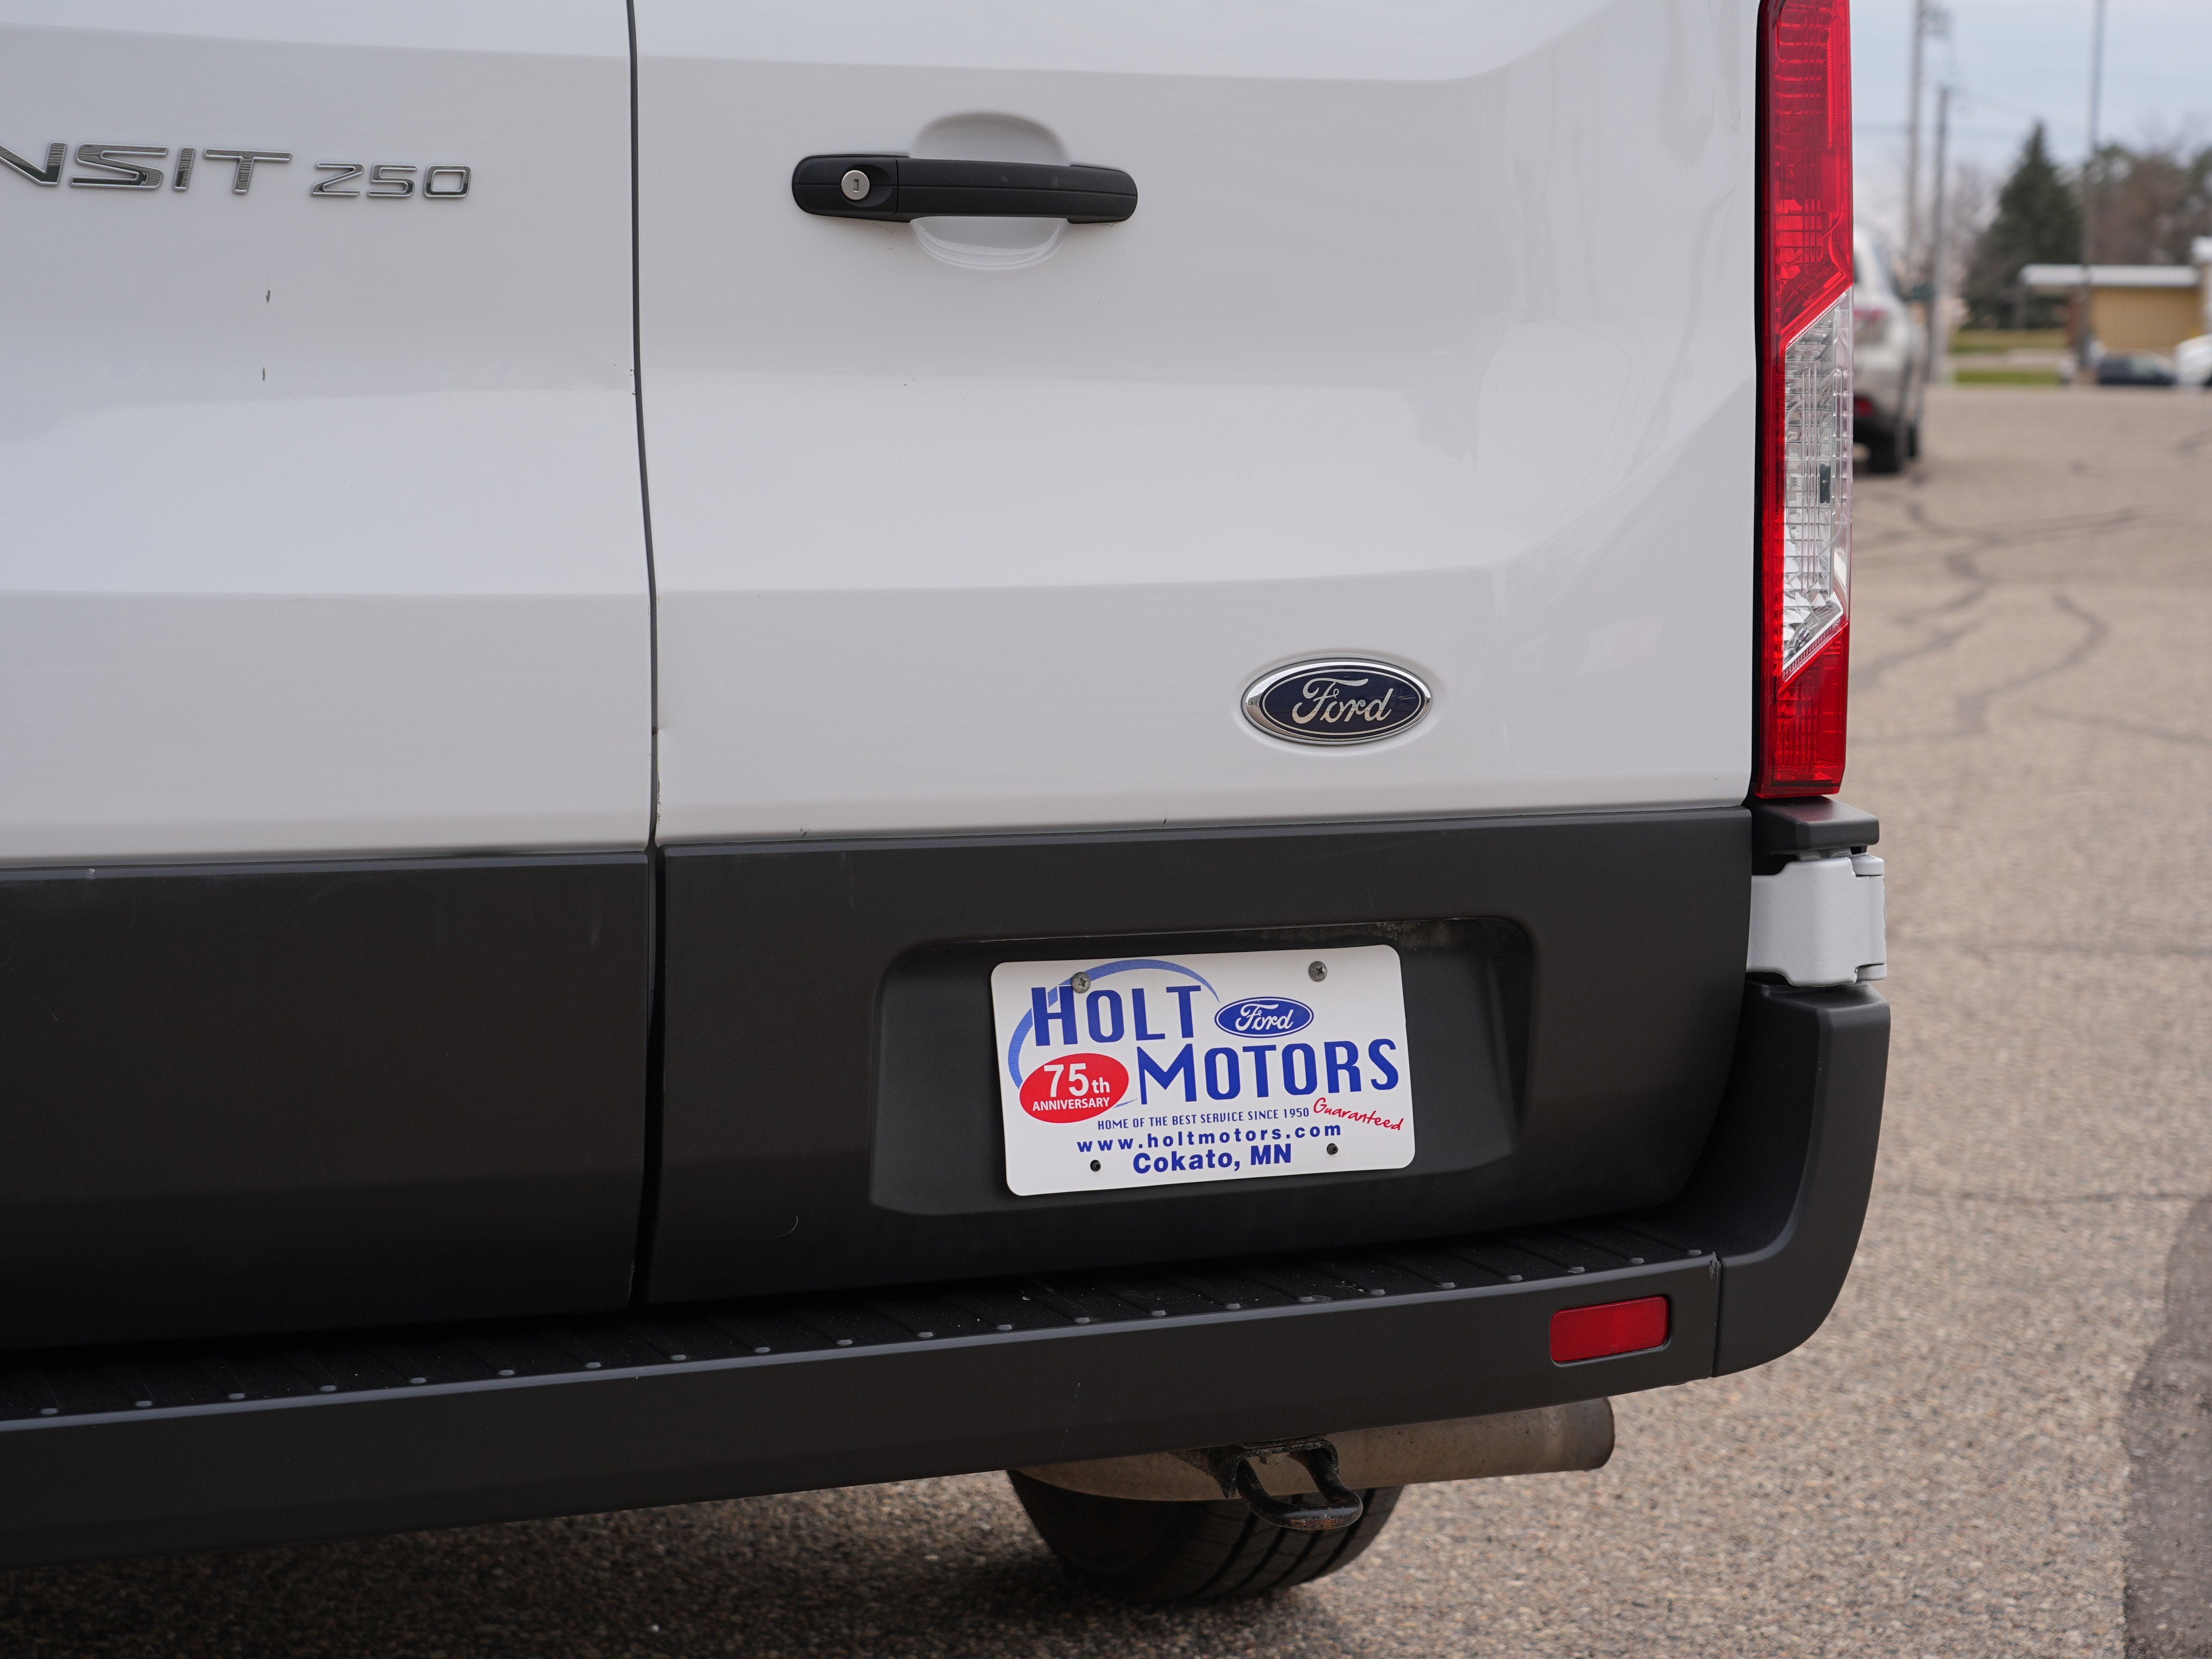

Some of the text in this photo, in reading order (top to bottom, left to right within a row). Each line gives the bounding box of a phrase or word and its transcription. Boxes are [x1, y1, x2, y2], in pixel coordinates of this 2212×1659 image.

[310, 161, 472, 198] 250
[1292, 677, 1394, 724] Ford
[1031, 985, 1202, 1047] HOLT
[1235, 1003, 1294, 1031] Ford
[1043, 1063, 1110, 1097] 75th
[1137, 1038, 1399, 1105] MOTORS
[1032, 1097, 1110, 1111] ANNIVERSARY
[1098, 1108, 1309, 1130] HOME OF THE BEST SERVICE SINCE 1950
[1313, 1097, 1404, 1130] Guaranteed
[1076, 1124, 1341, 1153] www.holtmotors.com
[1133, 1143, 1292, 1174] Cokato, MN
